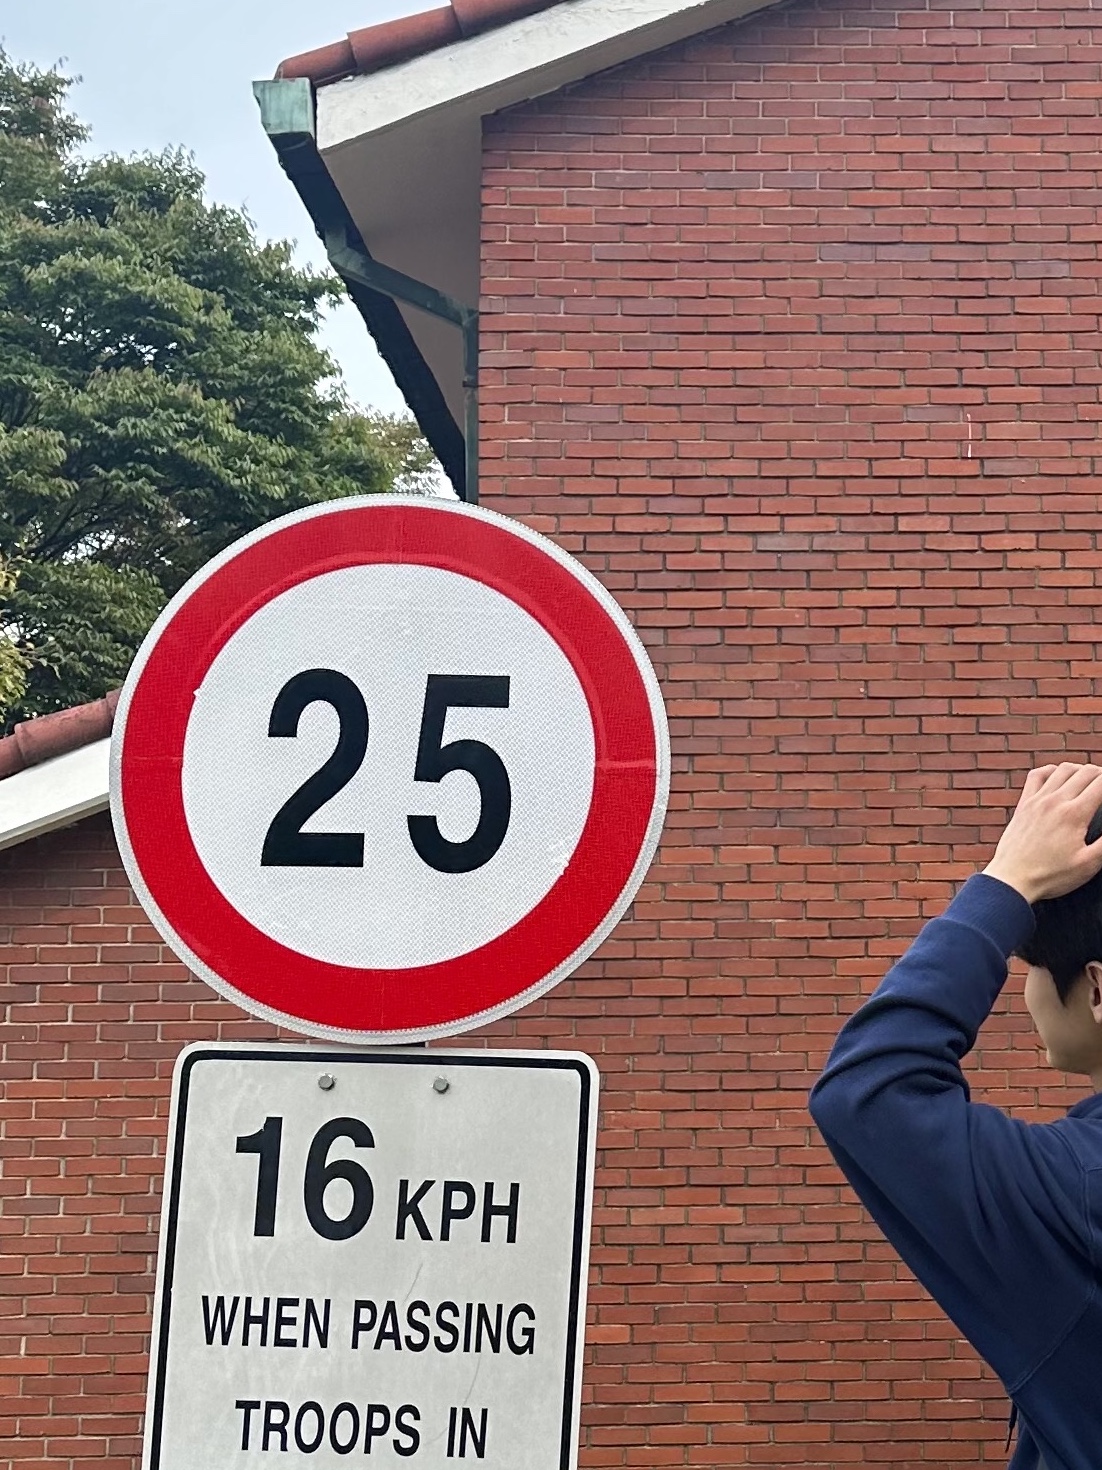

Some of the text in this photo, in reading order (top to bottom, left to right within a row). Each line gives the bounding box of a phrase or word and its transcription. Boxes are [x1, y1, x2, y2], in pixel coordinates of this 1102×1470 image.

[260, 668, 511, 873] 25
[235, 1117, 520, 1244] 16 KPH
[201, 1295, 536, 1355] WHEN PASSING
[235, 1400, 488, 1458] TROOPS IN
